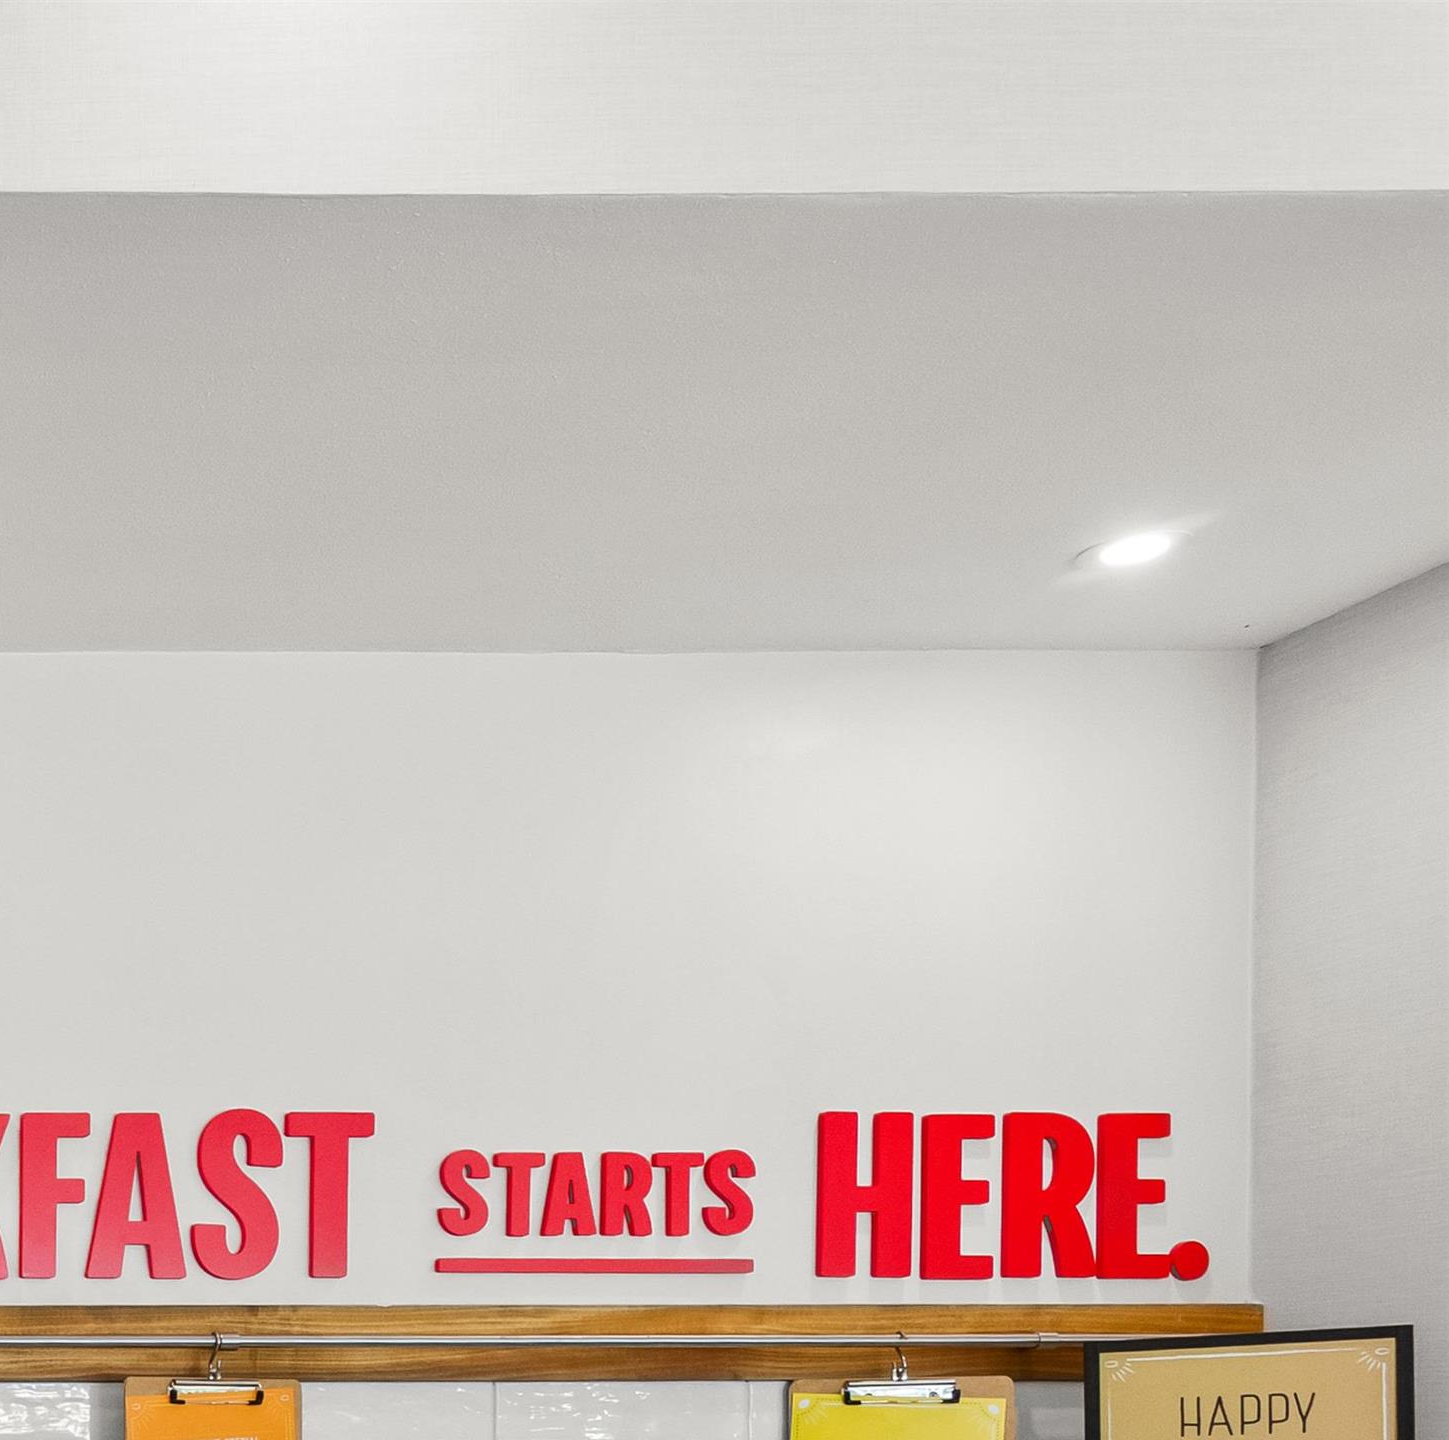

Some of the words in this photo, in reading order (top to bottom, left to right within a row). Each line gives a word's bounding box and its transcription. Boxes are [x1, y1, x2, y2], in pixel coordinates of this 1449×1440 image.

[436, 1148, 756, 1238] STARTS
[814, 1110, 1210, 1281] HERE.
[1179, 1391, 1316, 1439] HAPPY
